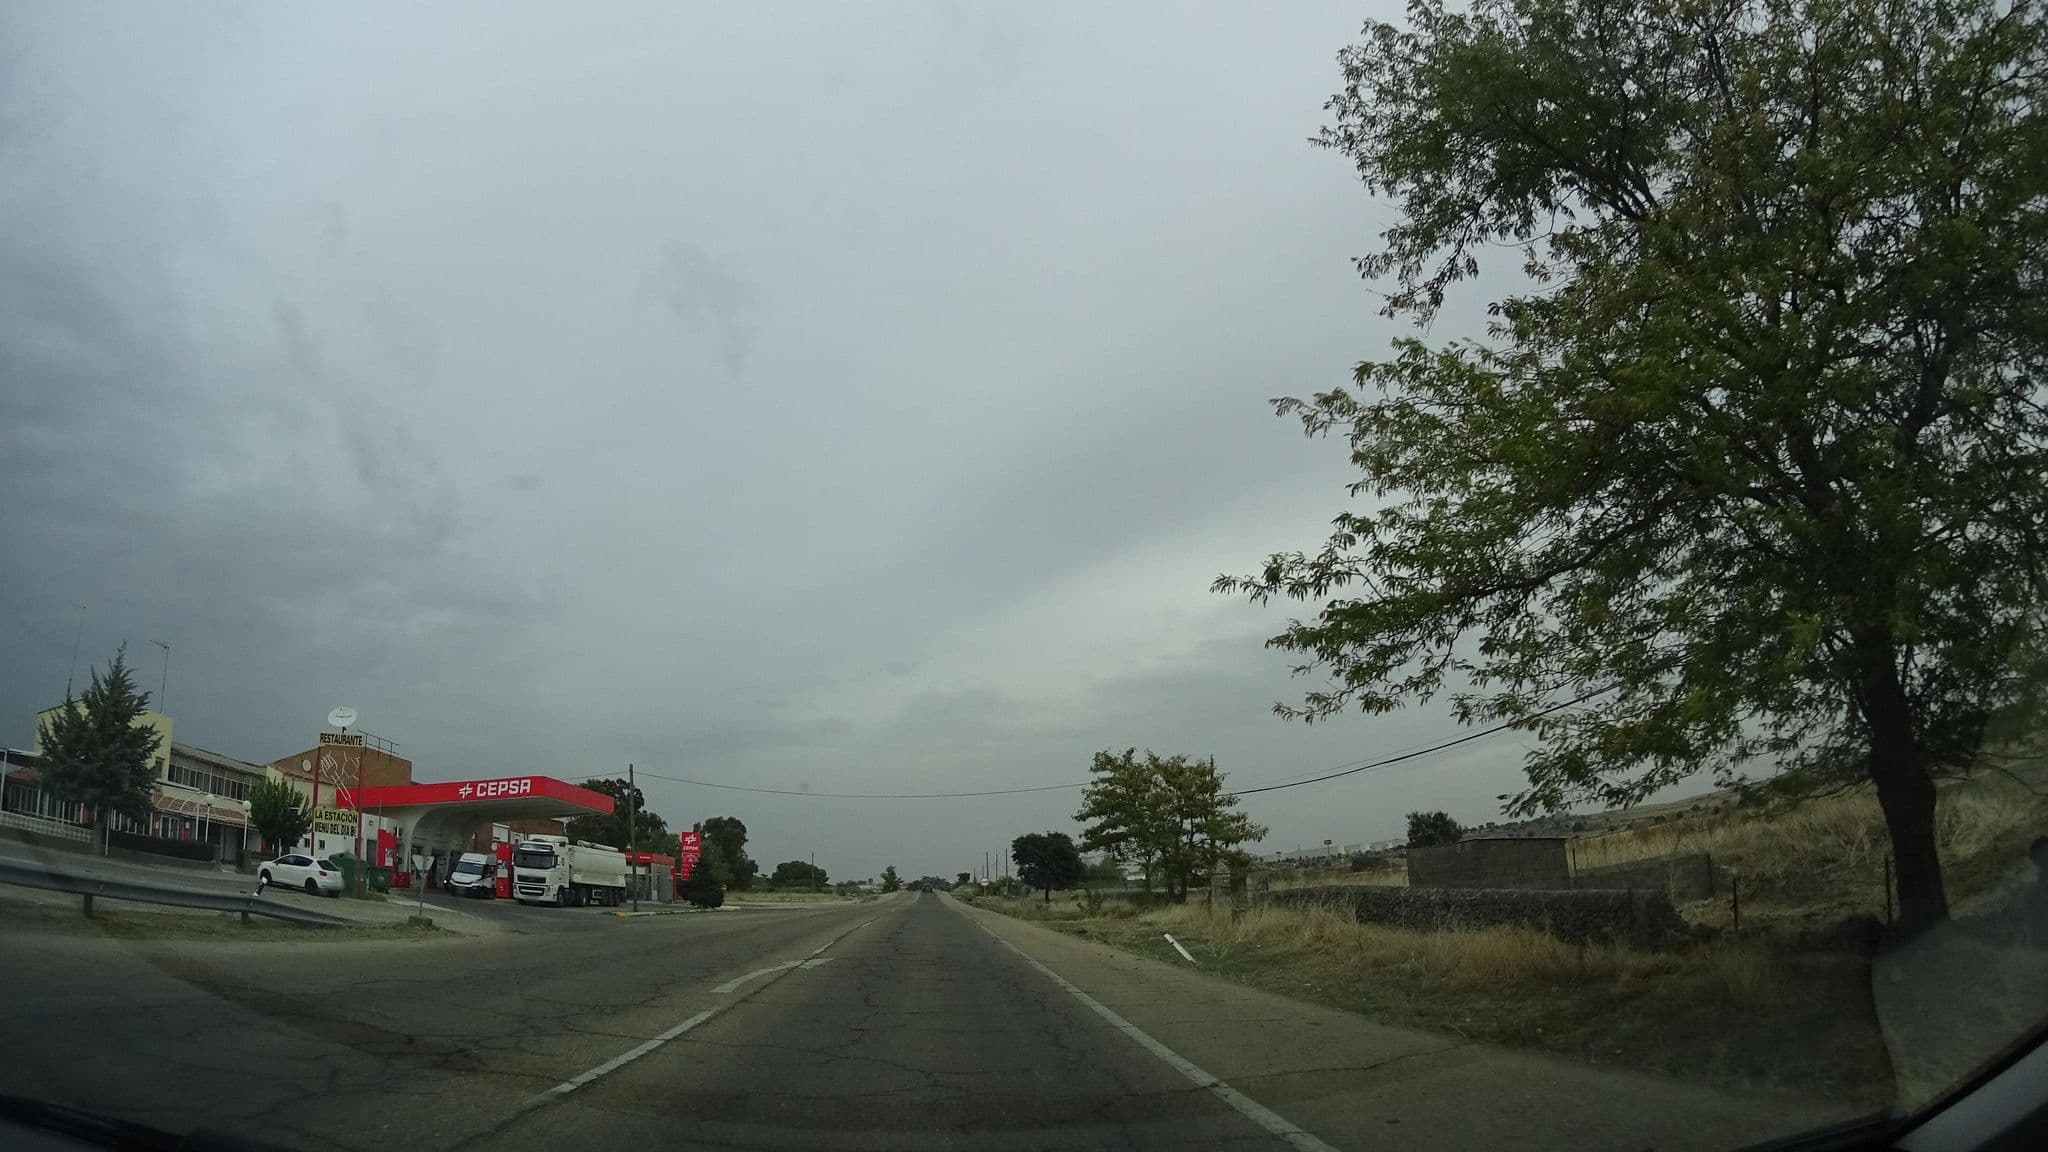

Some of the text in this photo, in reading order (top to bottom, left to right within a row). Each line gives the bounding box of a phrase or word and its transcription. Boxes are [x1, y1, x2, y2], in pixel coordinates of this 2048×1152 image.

[320, 733, 362, 746] RESTAURANTE
[476, 779, 531, 797] CEPSA
[315, 810, 323, 819] LA
[330, 823, 339, 835] DEL
